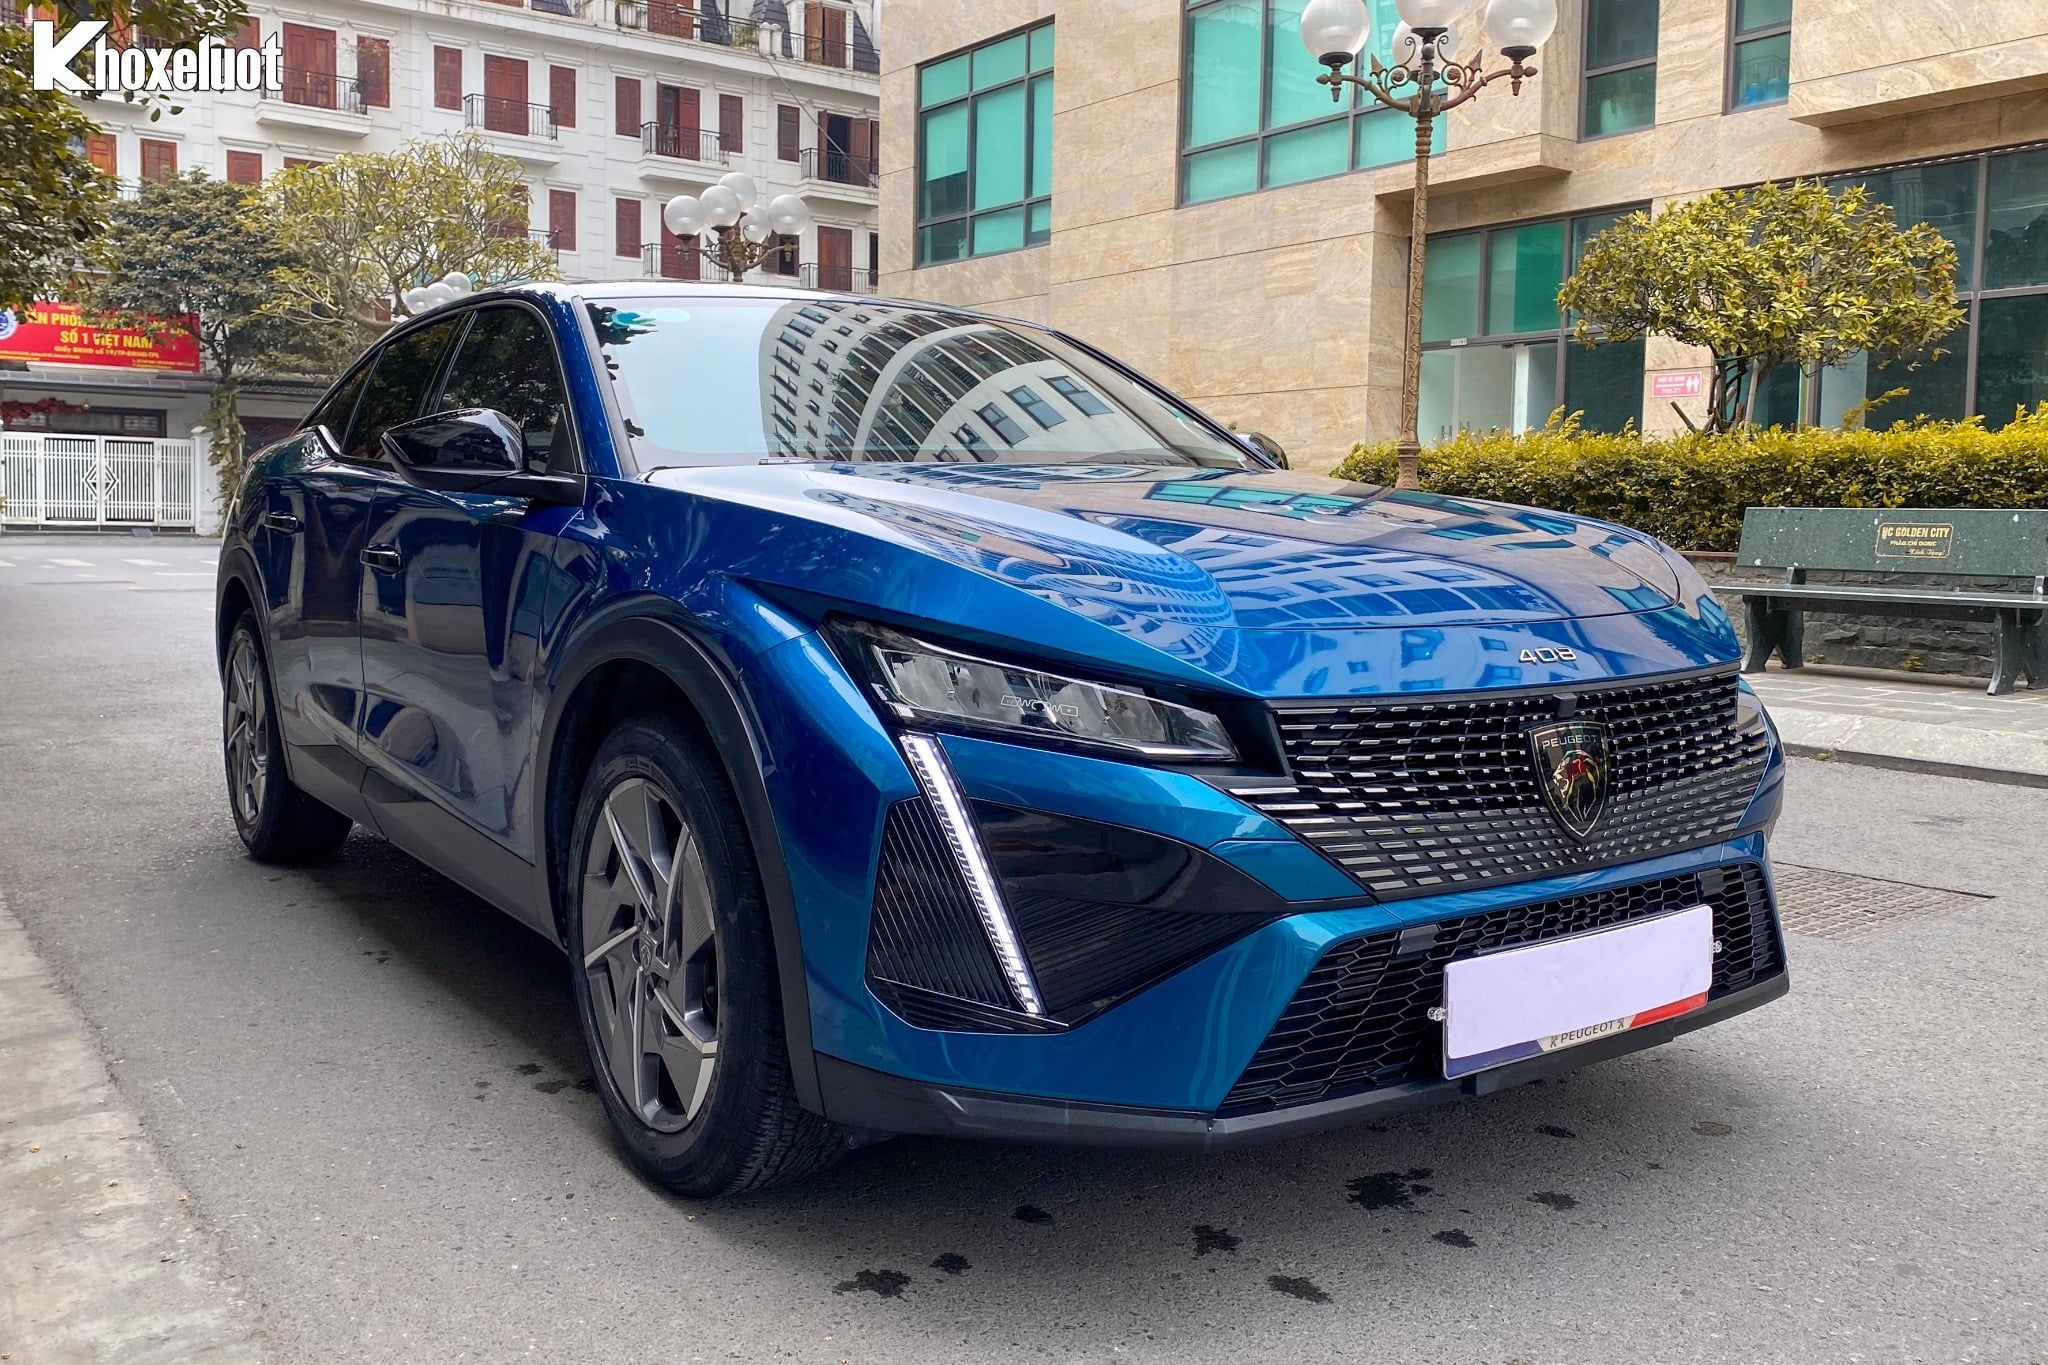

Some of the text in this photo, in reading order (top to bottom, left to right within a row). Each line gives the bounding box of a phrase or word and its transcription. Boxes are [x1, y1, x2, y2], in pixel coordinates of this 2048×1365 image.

[60, 327, 153, 350] SỐ 1 VIỆT NAM
[1895, 526, 1928, 538] GOLDEN
[1930, 527, 1950, 538] CITY
[1519, 647, 1577, 666] 408
[1541, 734, 1598, 750] PEUGEOT
[1560, 1020, 1615, 1043] PEUGEOT
